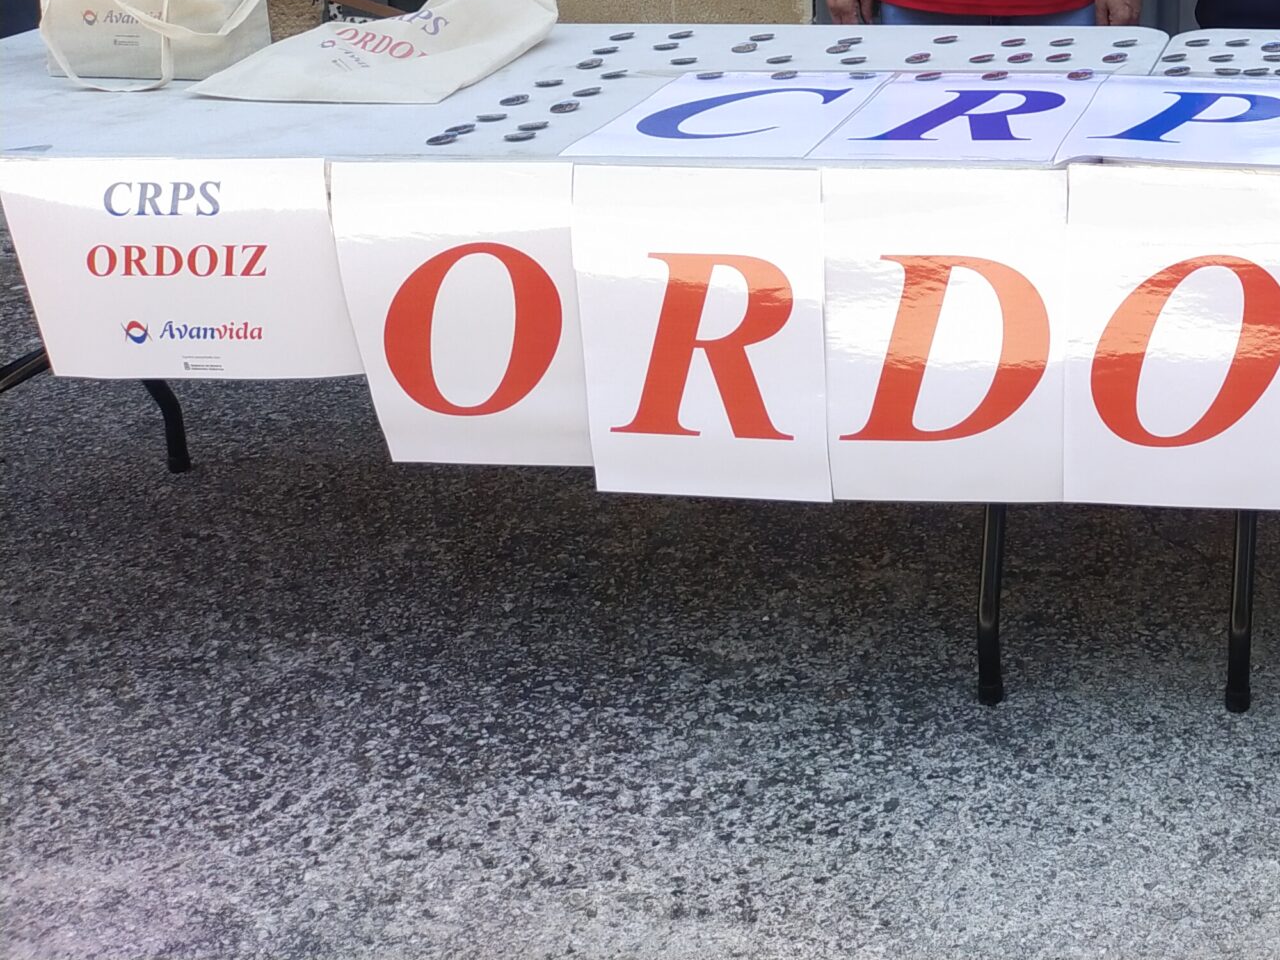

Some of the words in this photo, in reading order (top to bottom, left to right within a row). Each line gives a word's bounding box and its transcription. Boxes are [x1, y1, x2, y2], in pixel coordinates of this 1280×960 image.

[336, 28, 428, 59] ORDO
[104, 181, 221, 217] CRPS
[86, 244, 268, 277] ORDOIZ
[159, 320, 263, 341] Avanvida
